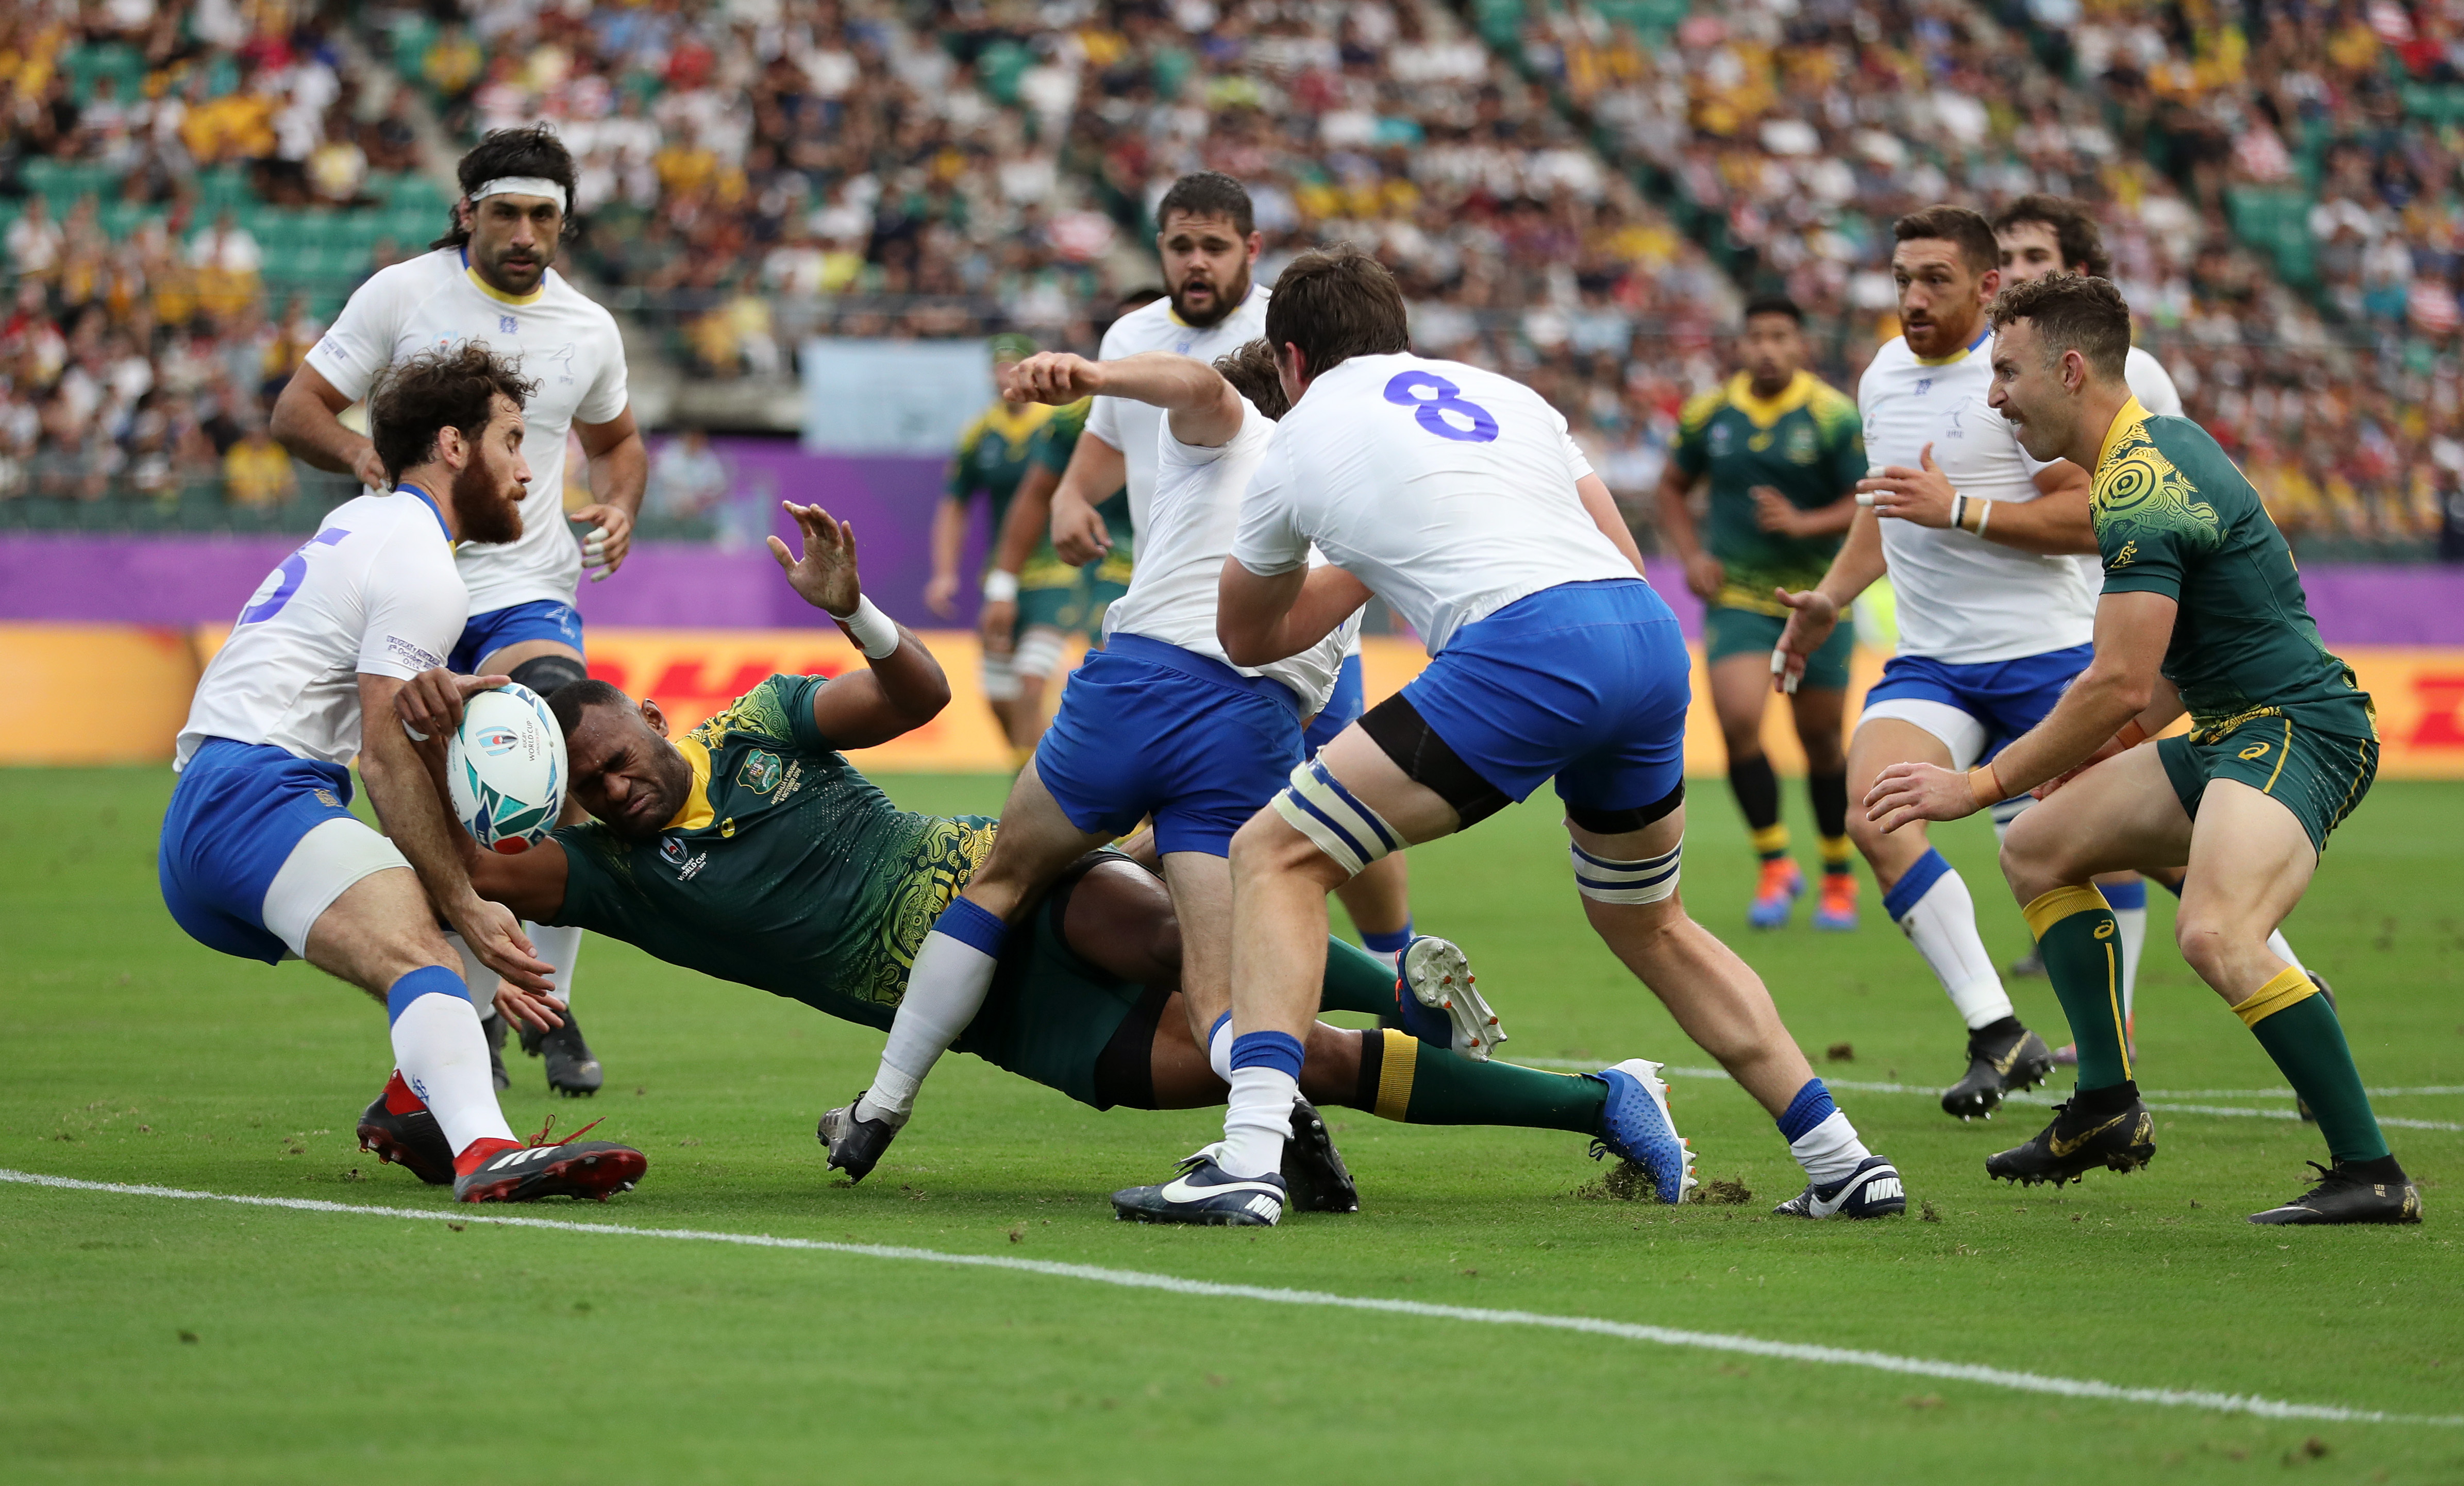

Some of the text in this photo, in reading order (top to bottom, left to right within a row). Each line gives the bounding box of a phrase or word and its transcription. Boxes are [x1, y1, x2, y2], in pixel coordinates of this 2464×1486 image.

[1383, 370, 1499, 443] 8
[770, 781, 788, 805] AUSTRALIA
[784, 759, 799, 778] URUGUAY
[782, 778, 797, 798] OCTOBER
[793, 767, 802, 779] 2019
[792, 782, 801, 792] OITA
[677, 862, 697, 881] WORLD
[681, 857, 694, 870] RUGBY
[1865, 1177, 1904, 1204] NIKE
